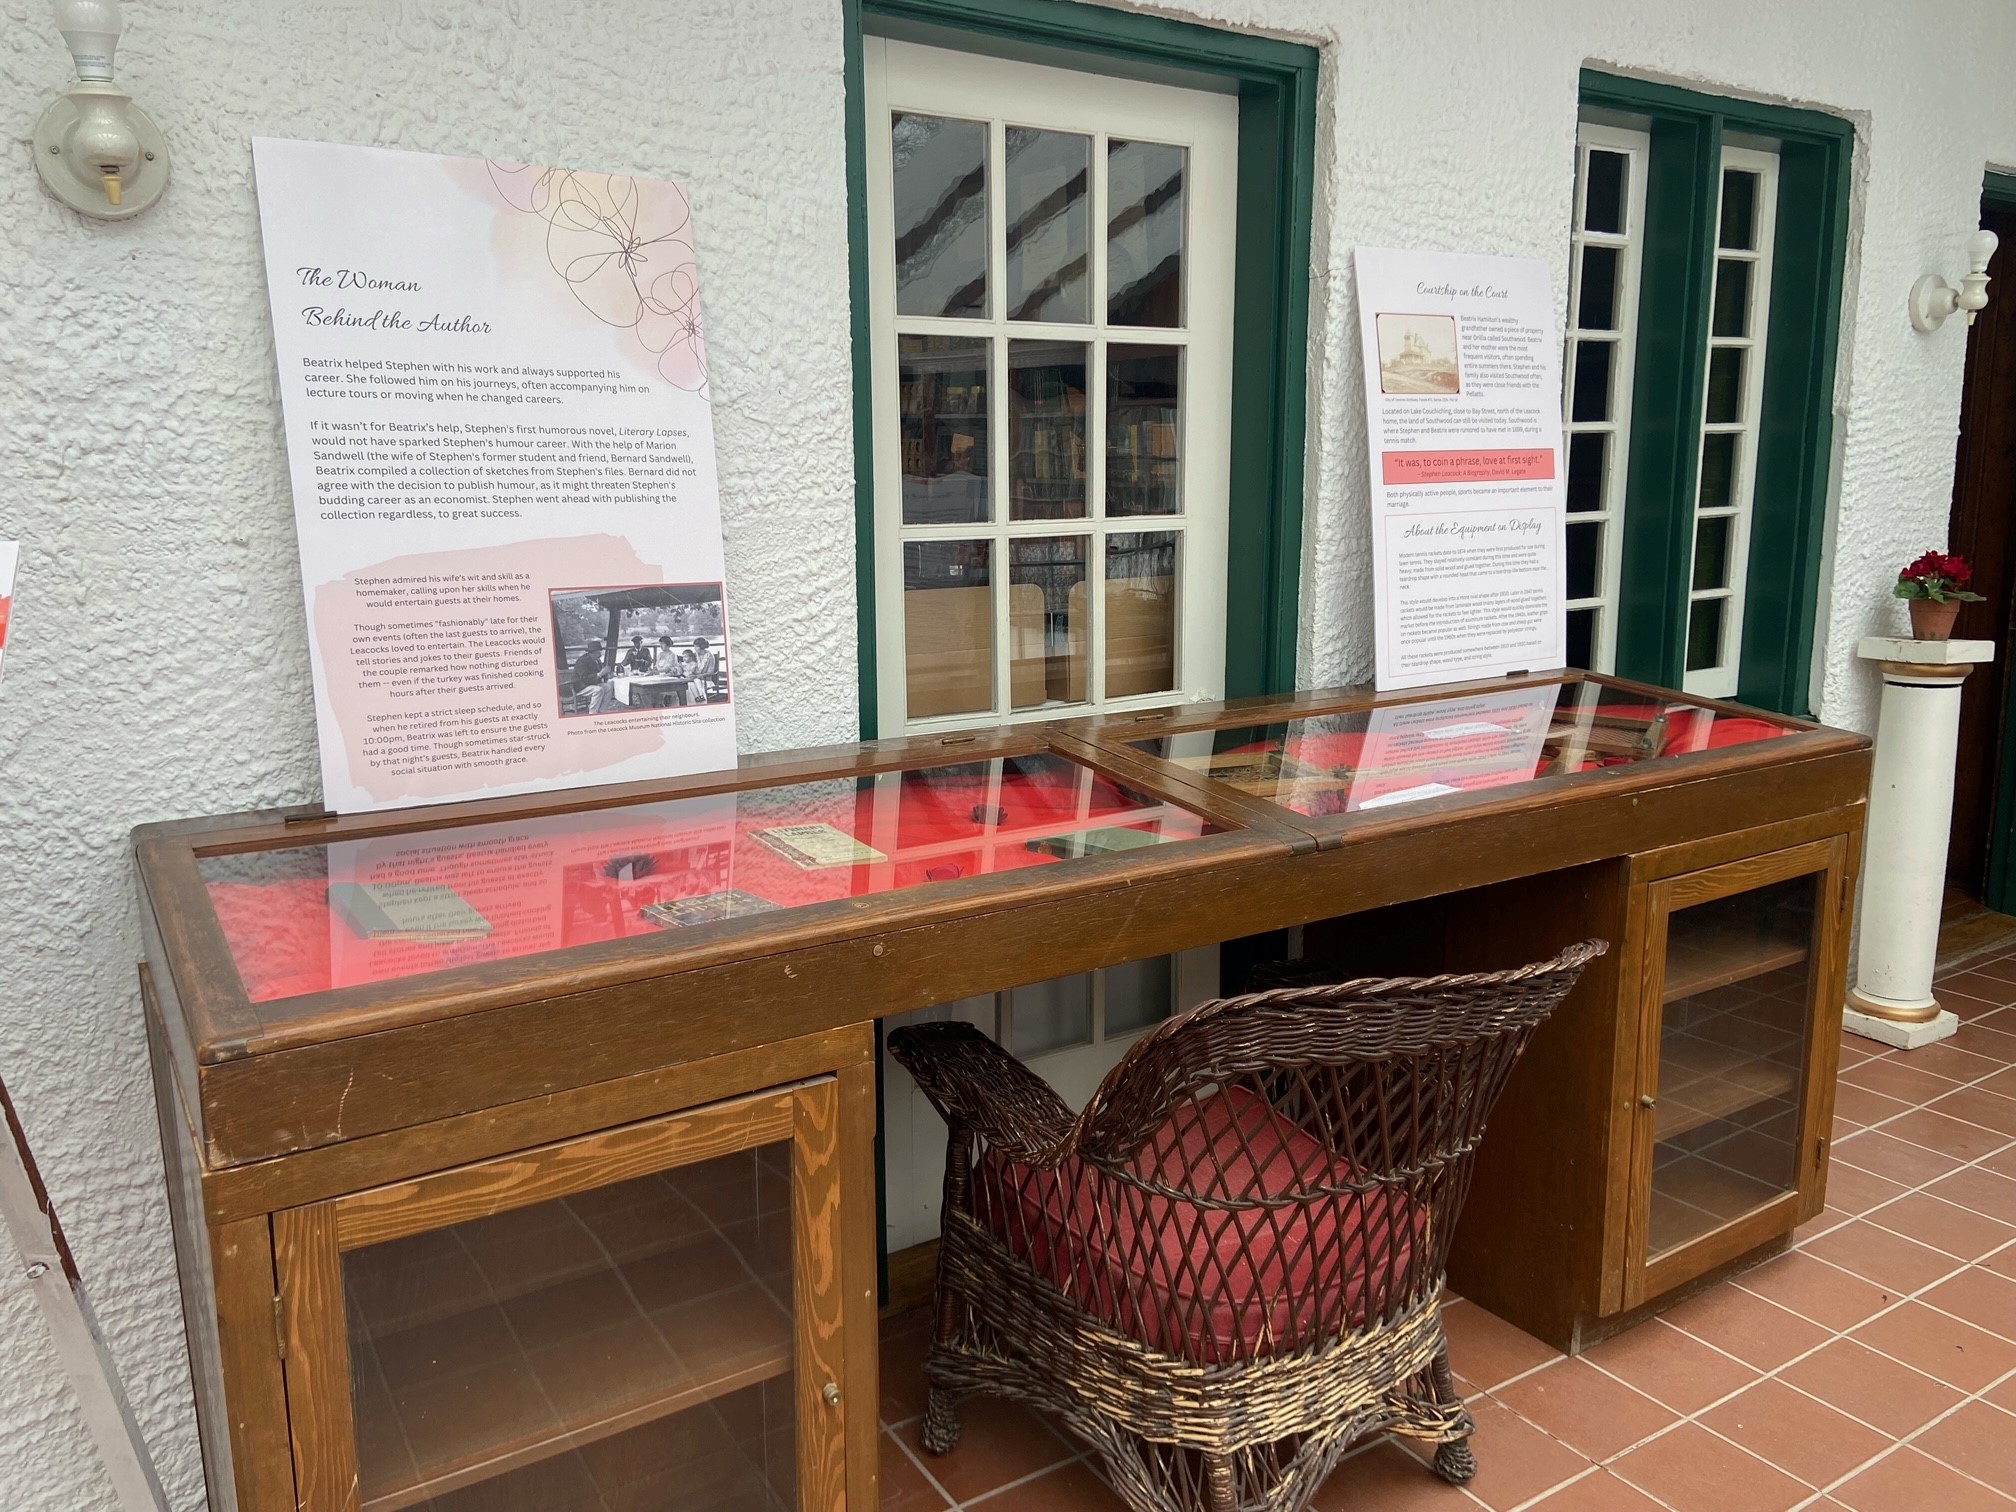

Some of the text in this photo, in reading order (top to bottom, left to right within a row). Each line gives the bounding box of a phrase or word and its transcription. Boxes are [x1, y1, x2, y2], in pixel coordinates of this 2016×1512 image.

[296, 266, 422, 292] The Woman
[1416, 281, 1509, 300] Courtship on the Court
[301, 306, 492, 334] Behind the Author
[302, 357, 621, 379] Beatrix helped Stephen with his work and always supported his
[304, 373, 650, 394] career. She followed him on his journeys, often accompanying him on
[305, 387, 564, 405] lecture tours or moving when he changed careers.
[310, 420, 319, 431] If
[320, 420, 330, 431] it
[369, 421, 387, 432] for
[436, 422, 463, 435] help,
[464, 423, 515, 436] Stephen's
[516, 424, 537, 435] first
[538, 425, 587, 436] humorous
[588, 426, 617, 438] novel,
[618, 426, 655, 438] Literary
[656, 428, 690, 439] Lapses,
[311, 435, 677, 452] would not have sparked Stephen's humour career. With the help of Marion
[313, 450, 694, 465] Sandwell (the wife of Stephen's former student and friend, Bernard Sandwell),
[1405, 459, 1422, 469] was,
[1422, 458, 1432, 467] to
[1432, 456, 1449, 467] coin
[1449, 458, 1455, 466] a
[1455, 456, 1482, 468] phrase,
[1482, 456, 1498, 466] love
[1498, 456, 1507, 465] at
[1506, 455, 1522, 465] first
[1420, 470, 1442, 479] Stephen
[1466, 469, 1492, 478] Biography,
[1491, 468, 1505, 476] David
[1511, 468, 1527, 476] Legate
[1386, 491, 1399, 499] Both
[1399, 490, 1424, 499] physically
[1439, 488, 1458, 497] people,
[1472, 487, 1491, 495] became
[1497, 487, 1520, 495] important
[1403, 517, 1542, 540] About the Equipment on Display
[353, 576, 391, 587] Stephen
[392, 575, 428, 585] admired
[428, 575, 442, 583] his
[467, 573, 480, 582] wit
[481, 572, 497, 581] and
[497, 572, 514, 581] skill
[355, 583, 531, 597] homemaker, calling upon her skills when he
[365, 599, 393, 608] would
[394, 597, 434, 607] entertain
[434, 597, 462, 607] guests
[472, 595, 492, 604] their
[492, 595, 522, 603] homes.
[604, 718, 628, 726] Leacocks
[628, 715, 660, 724] entertaining
[658, 713, 672, 721] their
[671, 712, 700, 720] neighbours.
[606, 725, 629, 733] Leacock
[650, 721, 672, 729] National
[672, 719, 692, 727] Historic
[701, 716, 726, 724] collection
